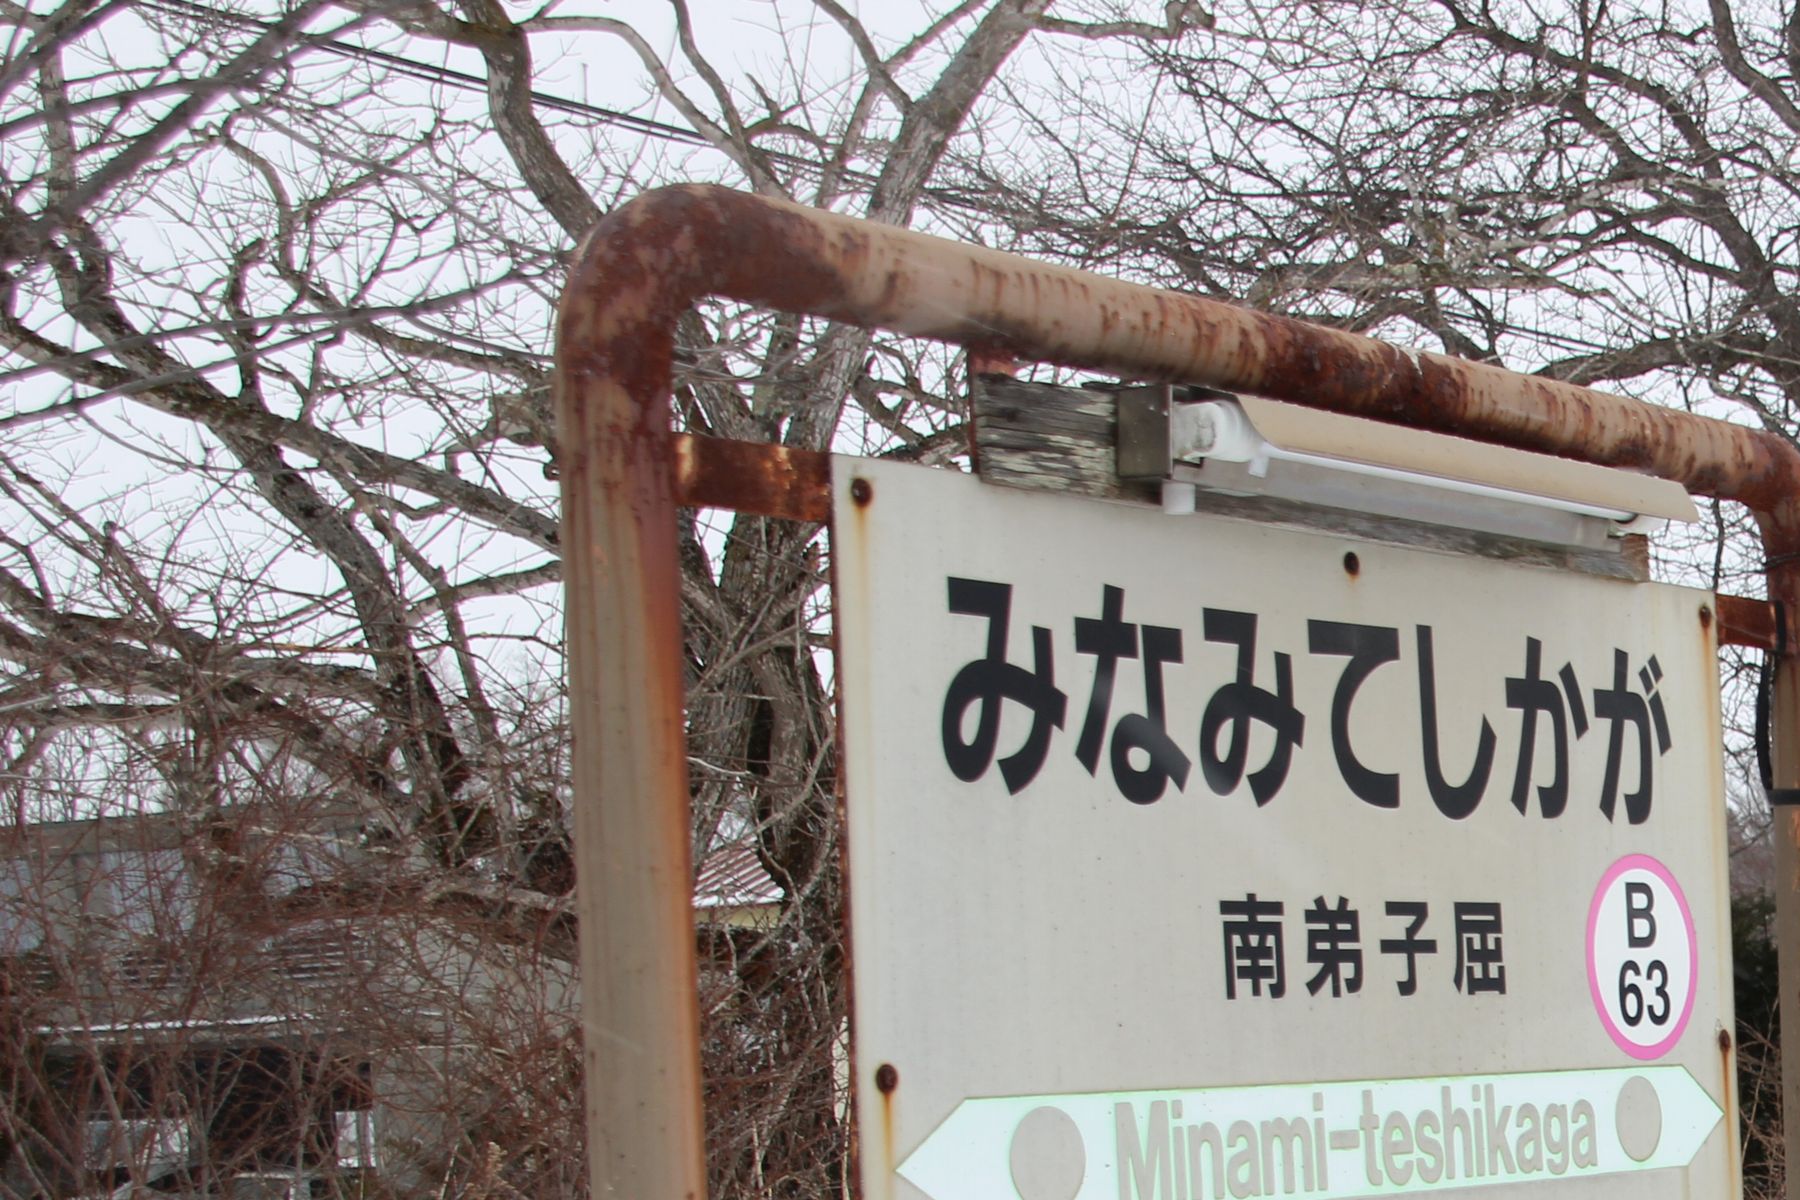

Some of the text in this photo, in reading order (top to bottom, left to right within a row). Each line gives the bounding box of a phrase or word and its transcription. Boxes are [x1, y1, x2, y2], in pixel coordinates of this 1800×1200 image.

[942, 576, 1672, 825] みなみてしかが
[1220, 893, 1508, 1000] 南弟子屈
[1625, 882, 1656, 948] B
[1618, 959, 1672, 1027] 63
